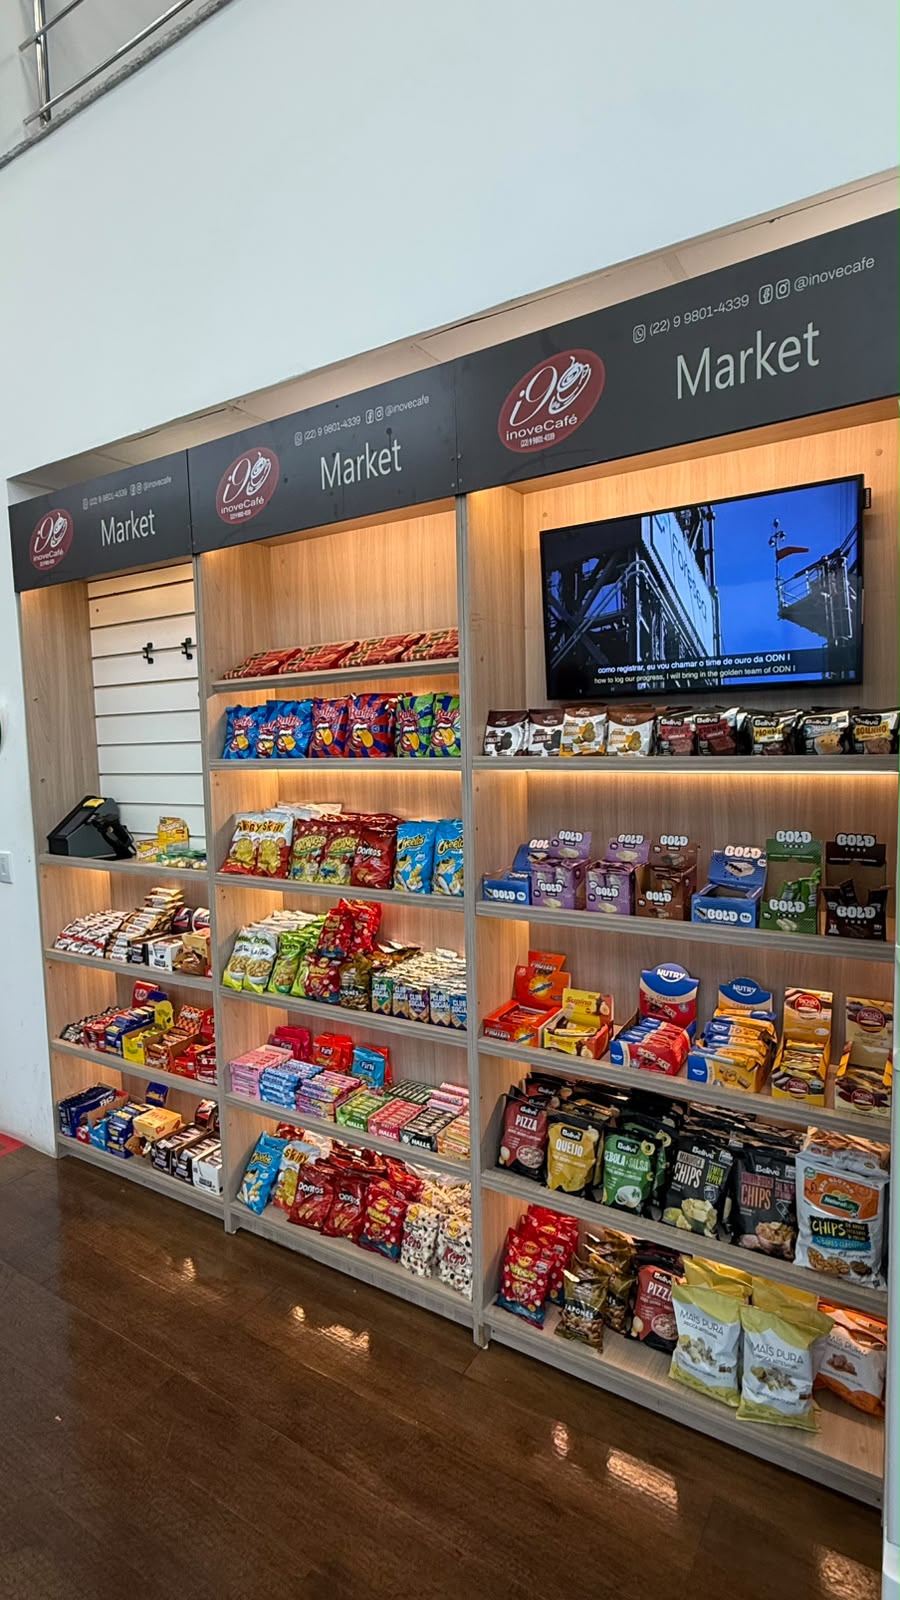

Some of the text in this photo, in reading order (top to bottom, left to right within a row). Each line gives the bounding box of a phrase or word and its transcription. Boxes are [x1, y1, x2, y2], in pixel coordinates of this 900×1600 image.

[649, 255, 875, 337] (22) 9 9801-4339 @inovecafe
[675, 321, 820, 400] Market
[317, 427, 323, 437] 9
[323, 415, 361, 434] 9801-4339
[385, 394, 430, 417] @inovecafe
[506, 413, 578, 441] inoveCafé
[320, 438, 402, 490] Market
[220, 496, 265, 515] inoveCafé
[101, 509, 156, 547] Market
[33, 548, 64, 562] inoveCafé
[597, 666, 616, 674] como
[616, 664, 645, 673] registrar,
[670, 660, 697, 669] chamar
[705, 658, 721, 666] time
[723, 657, 733, 665] de
[734, 657, 752, 665] ouro
[765, 654, 785, 662] ODN
[614, 676, 623, 684] log
[636, 674, 665, 683] progress,
[682, 671, 698, 680] bring
[707, 669, 718, 677] the
[719, 667, 743, 678] golden
[744, 667, 762, 675] team
[772, 665, 791, 673] ODN
[349, 705, 378, 721] Ruffles
[356, 846, 382, 857] Doritos
[396, 834, 425, 852] Cheetos
[656, 968, 686, 979] NUTRY
[732, 983, 757, 993] NUTRY
[565, 995, 592, 1007] Supino
[345, 1119, 364, 1130] HALLS
[515, 1114, 538, 1132] PIZZA
[378, 1129, 397, 1139] HALLS
[411, 1138, 430, 1149] HALLS
[556, 1138, 584, 1158] QUEIJO
[691, 1145, 715, 1160] Belive
[673, 1162, 703, 1189] CHIPS
[756, 1164, 780, 1176] Belive
[298, 1181, 324, 1194] Doritos
[741, 1184, 772, 1210] CHIPS
[811, 1220, 846, 1237] CHIPS
[702, 1318, 724, 1336] PURA
[776, 1348, 804, 1364] PURA
